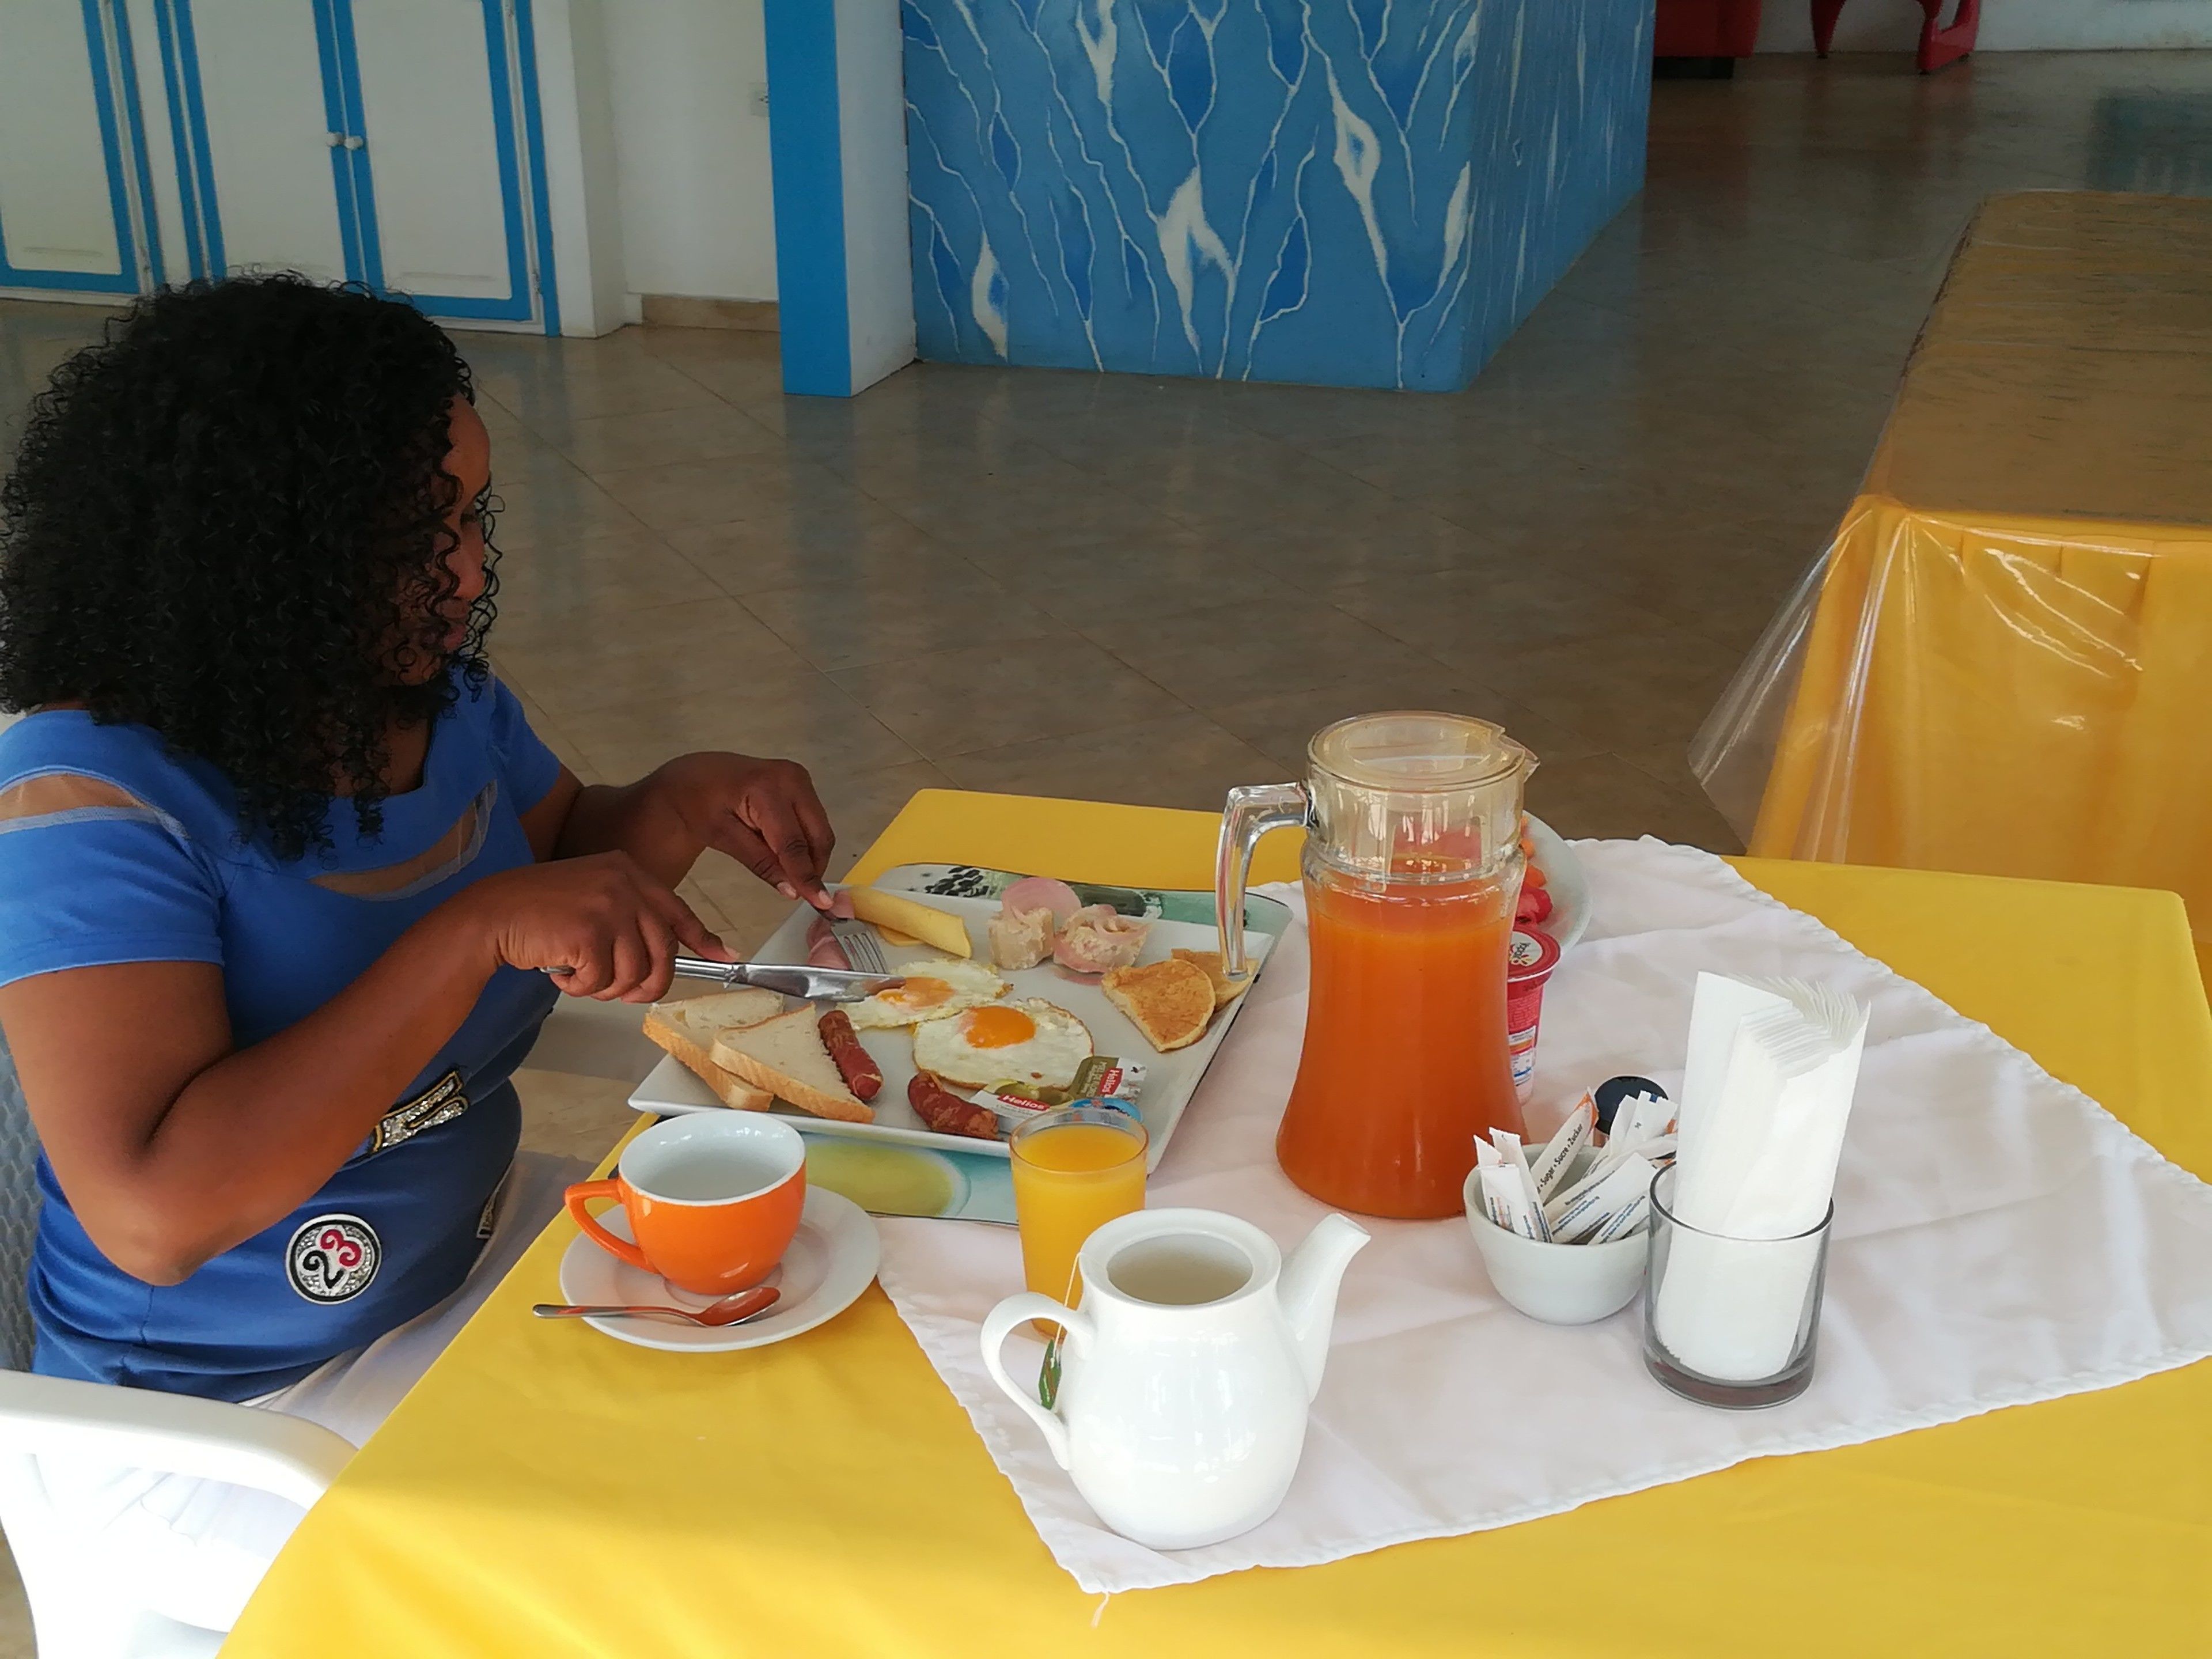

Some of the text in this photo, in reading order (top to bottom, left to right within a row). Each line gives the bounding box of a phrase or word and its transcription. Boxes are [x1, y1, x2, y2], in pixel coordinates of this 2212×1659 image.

[1003, 1095, 1045, 1109] Helios
[1101, 1069, 1120, 1093] Helios
[1540, 1166, 1555, 1185] Sugar
[1554, 1147, 1569, 1165] Sucre
[1567, 1123, 1583, 1146] Zucker
[302, 1228, 362, 1289] 23
